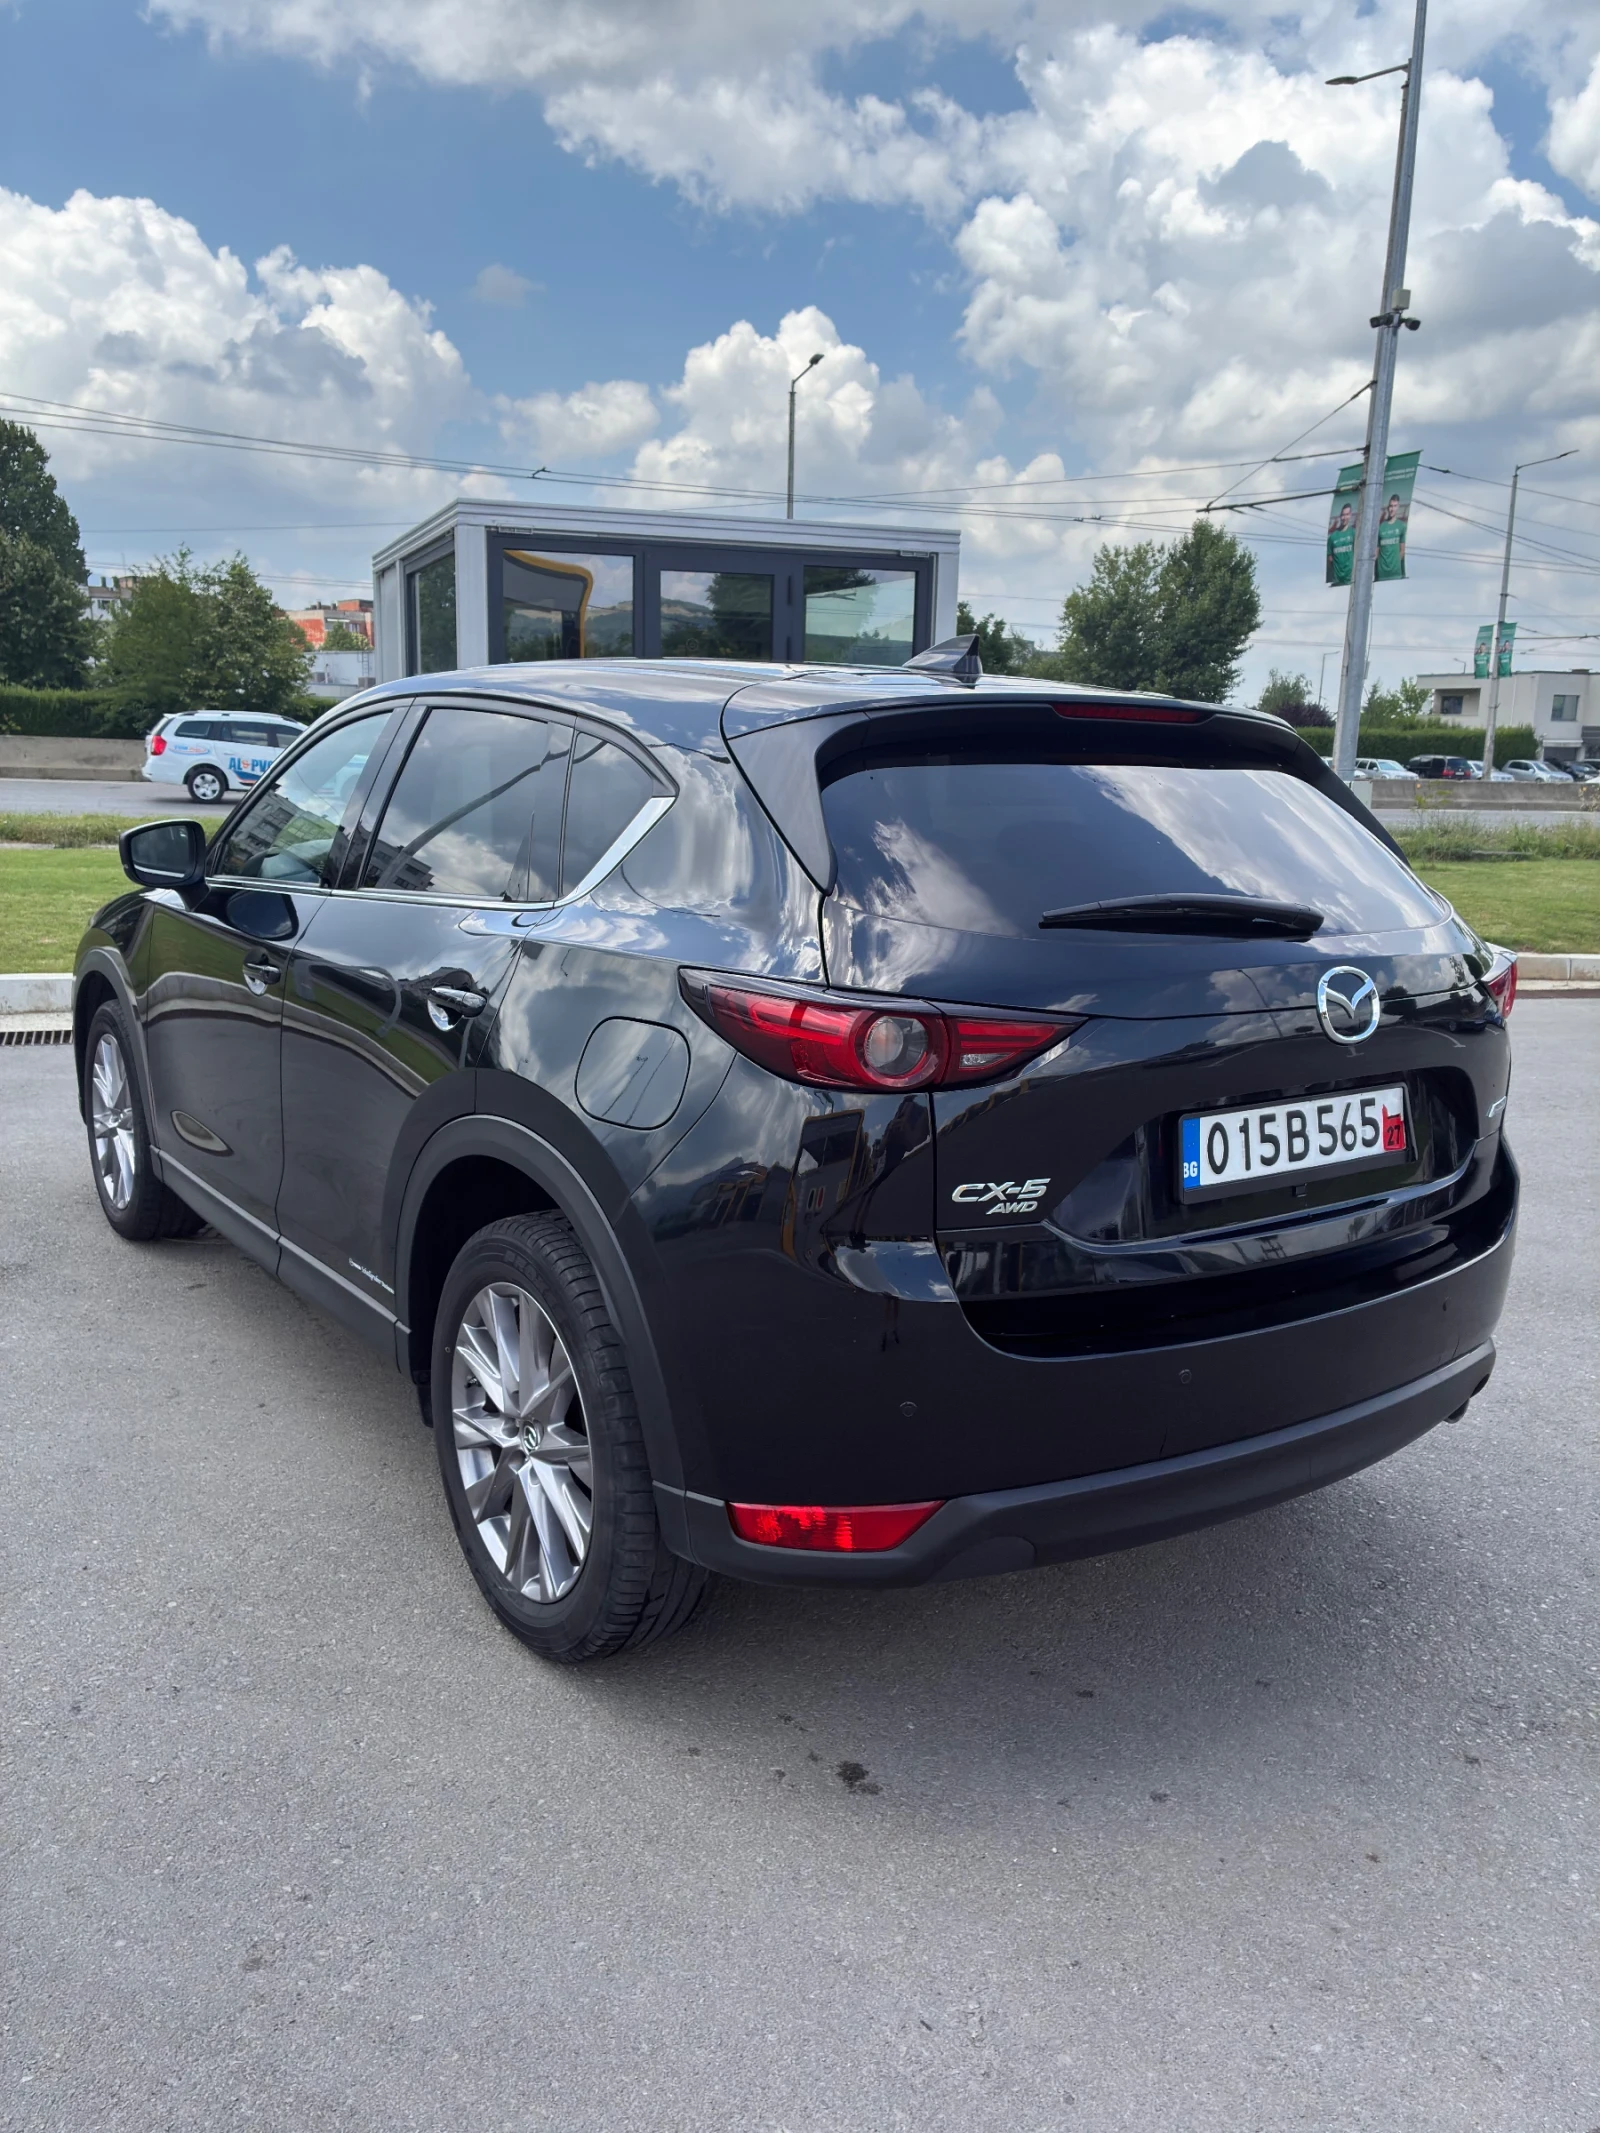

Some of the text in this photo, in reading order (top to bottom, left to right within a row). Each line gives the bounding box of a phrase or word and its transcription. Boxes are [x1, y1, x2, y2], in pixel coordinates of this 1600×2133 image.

[1206, 1097, 1381, 1175] 015B565
[1387, 1124, 1401, 1146] 27
[1183, 1160, 1198, 1179] BG
[951, 1178, 1051, 1203] CX-5
[985, 1200, 1038, 1215] AWD
